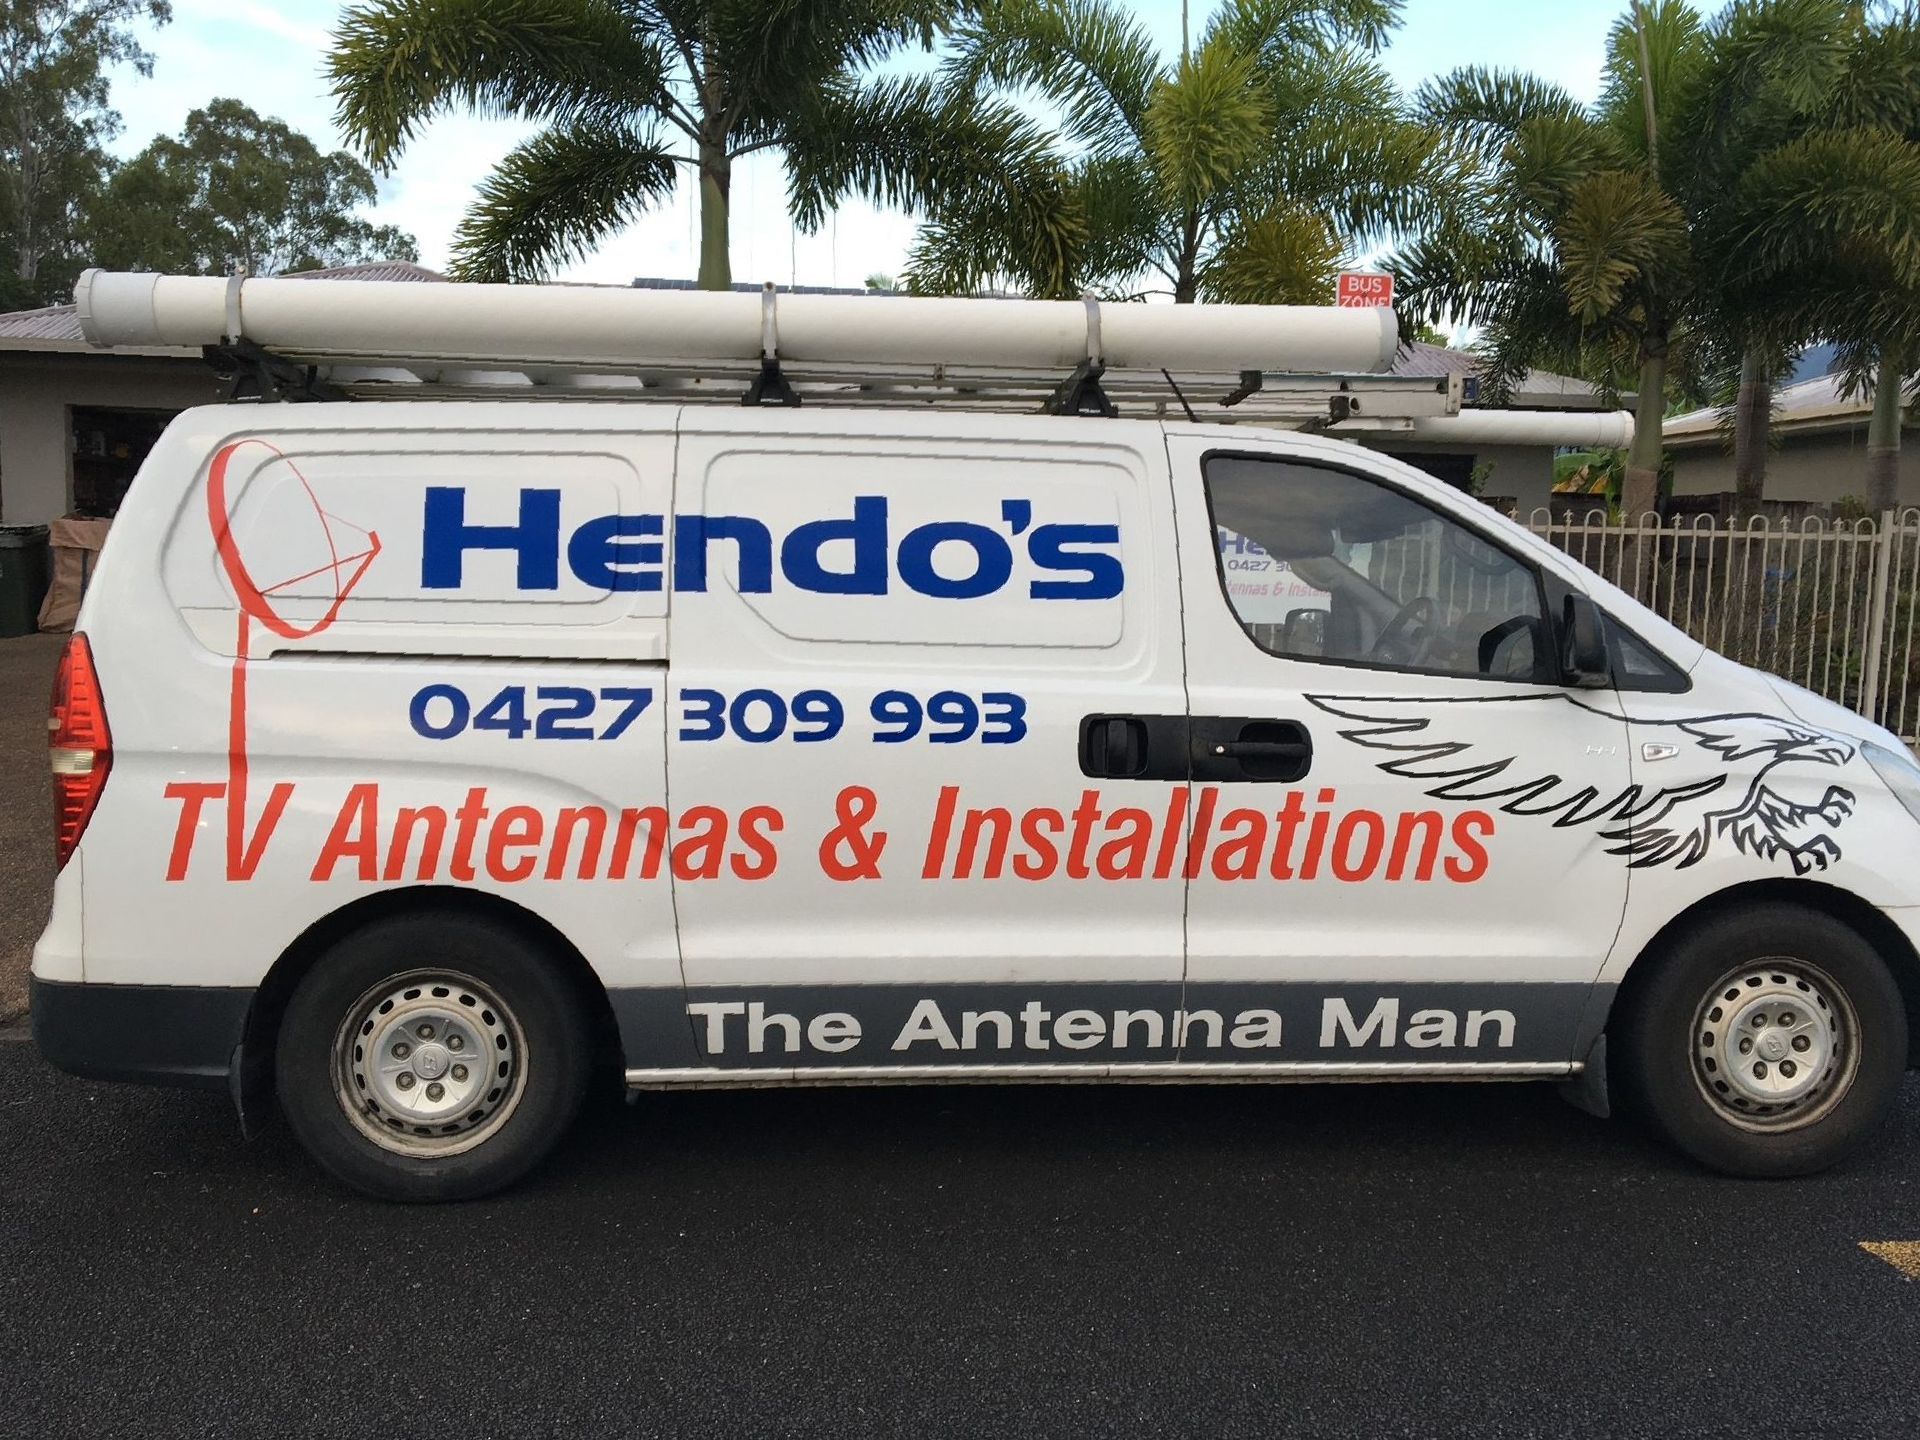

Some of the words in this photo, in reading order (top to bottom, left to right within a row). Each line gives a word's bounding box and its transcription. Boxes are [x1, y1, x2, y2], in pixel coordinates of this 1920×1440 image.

[1348, 276, 1383, 294] BUS
[422, 487, 1124, 600] Hendo's
[1227, 560, 1271, 572] 0427
[410, 685, 652, 740] 0427
[679, 689, 844, 743] 309
[870, 690, 1027, 744] 993
[165, 782, 294, 882] TV
[311, 783, 784, 883] Antennas
[818, 785, 888, 882] &
[921, 785, 1496, 884] Installations
[687, 1000, 862, 1055] The
[890, 999, 1282, 1052] Antenna
[1319, 997, 1516, 1049] Man
